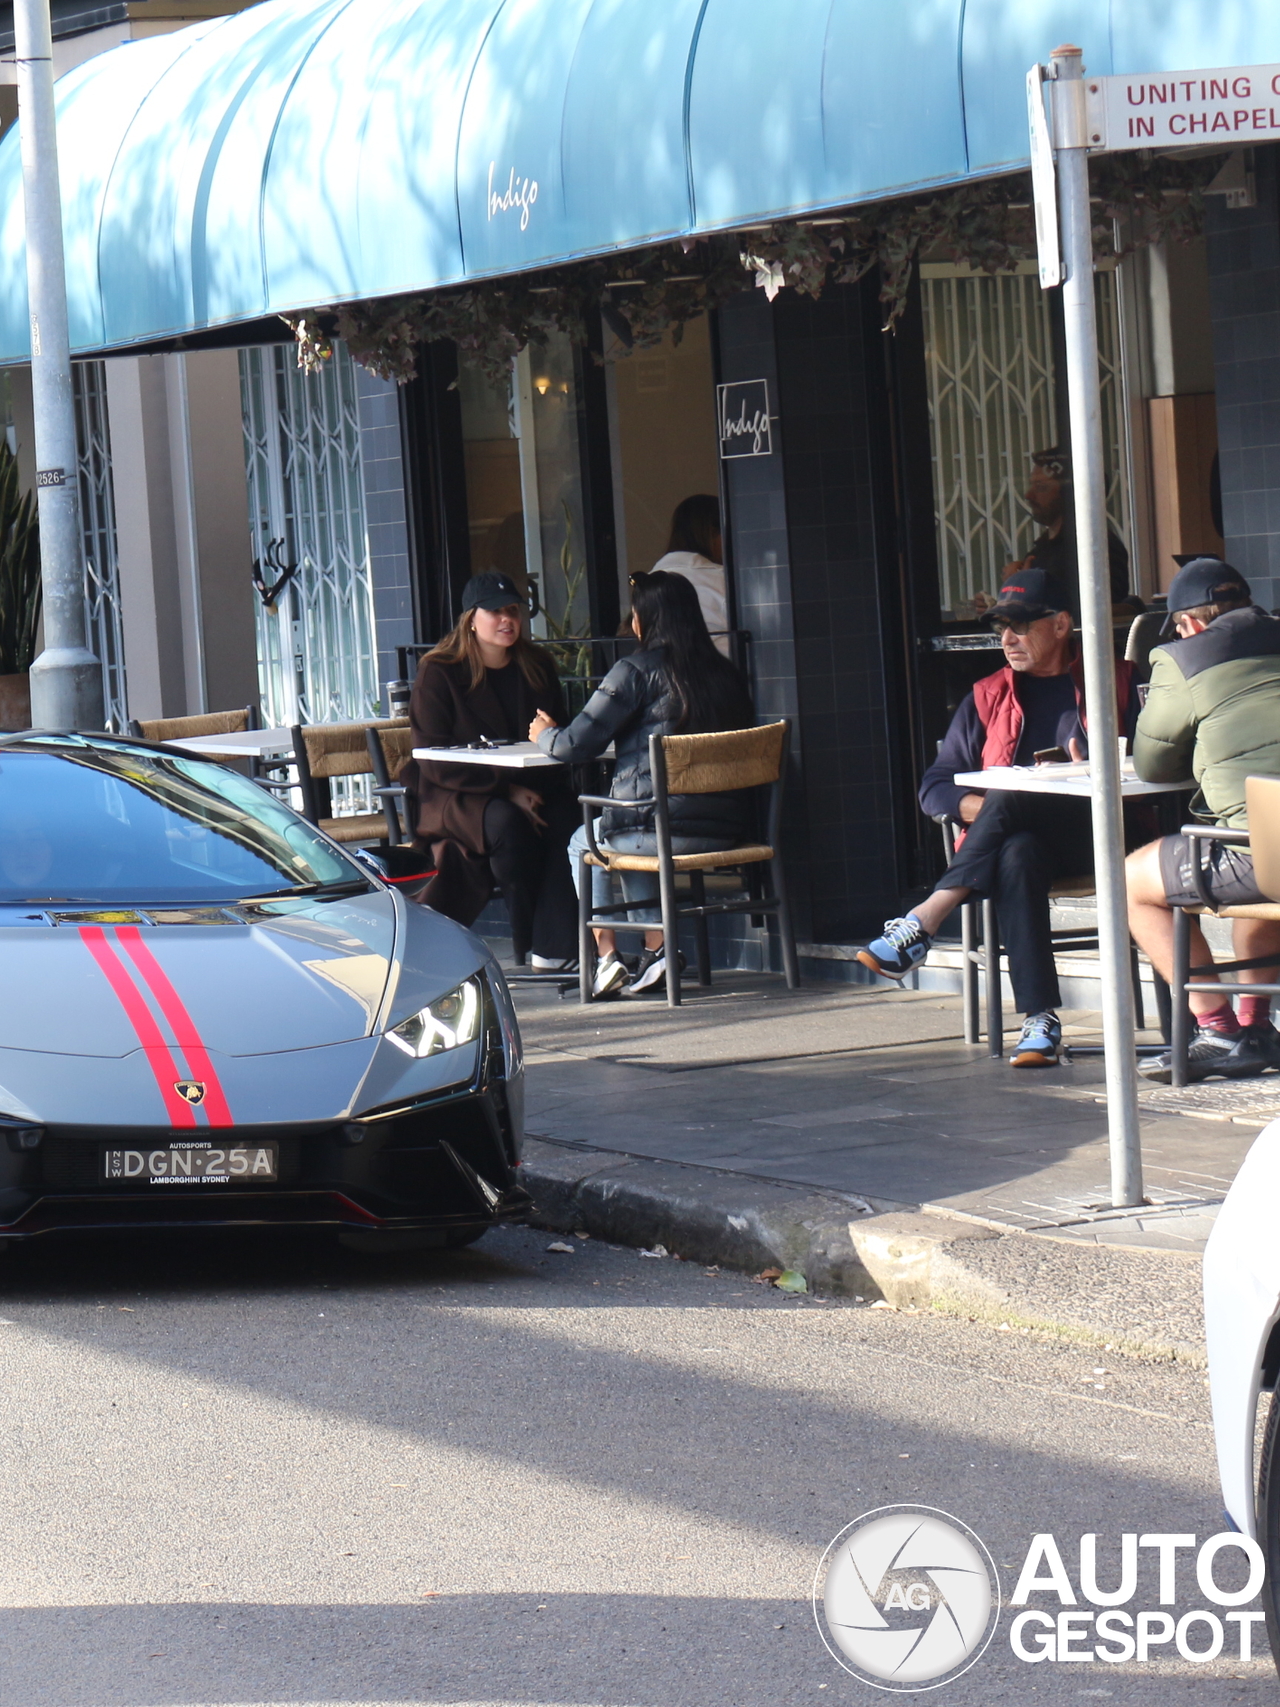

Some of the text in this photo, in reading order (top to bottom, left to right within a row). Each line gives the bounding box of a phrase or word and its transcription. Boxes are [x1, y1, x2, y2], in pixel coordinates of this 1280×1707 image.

[1127, 77, 1251, 106] UNITING
[1128, 108, 1280, 138] IN CHAPEL
[487, 160, 538, 231] Indigo
[722, 385, 769, 454] Indigo
[169, 1142, 212, 1150] AUTOSPORTS
[150, 1175, 230, 1184] LAMBORGHINI SYDNEY
